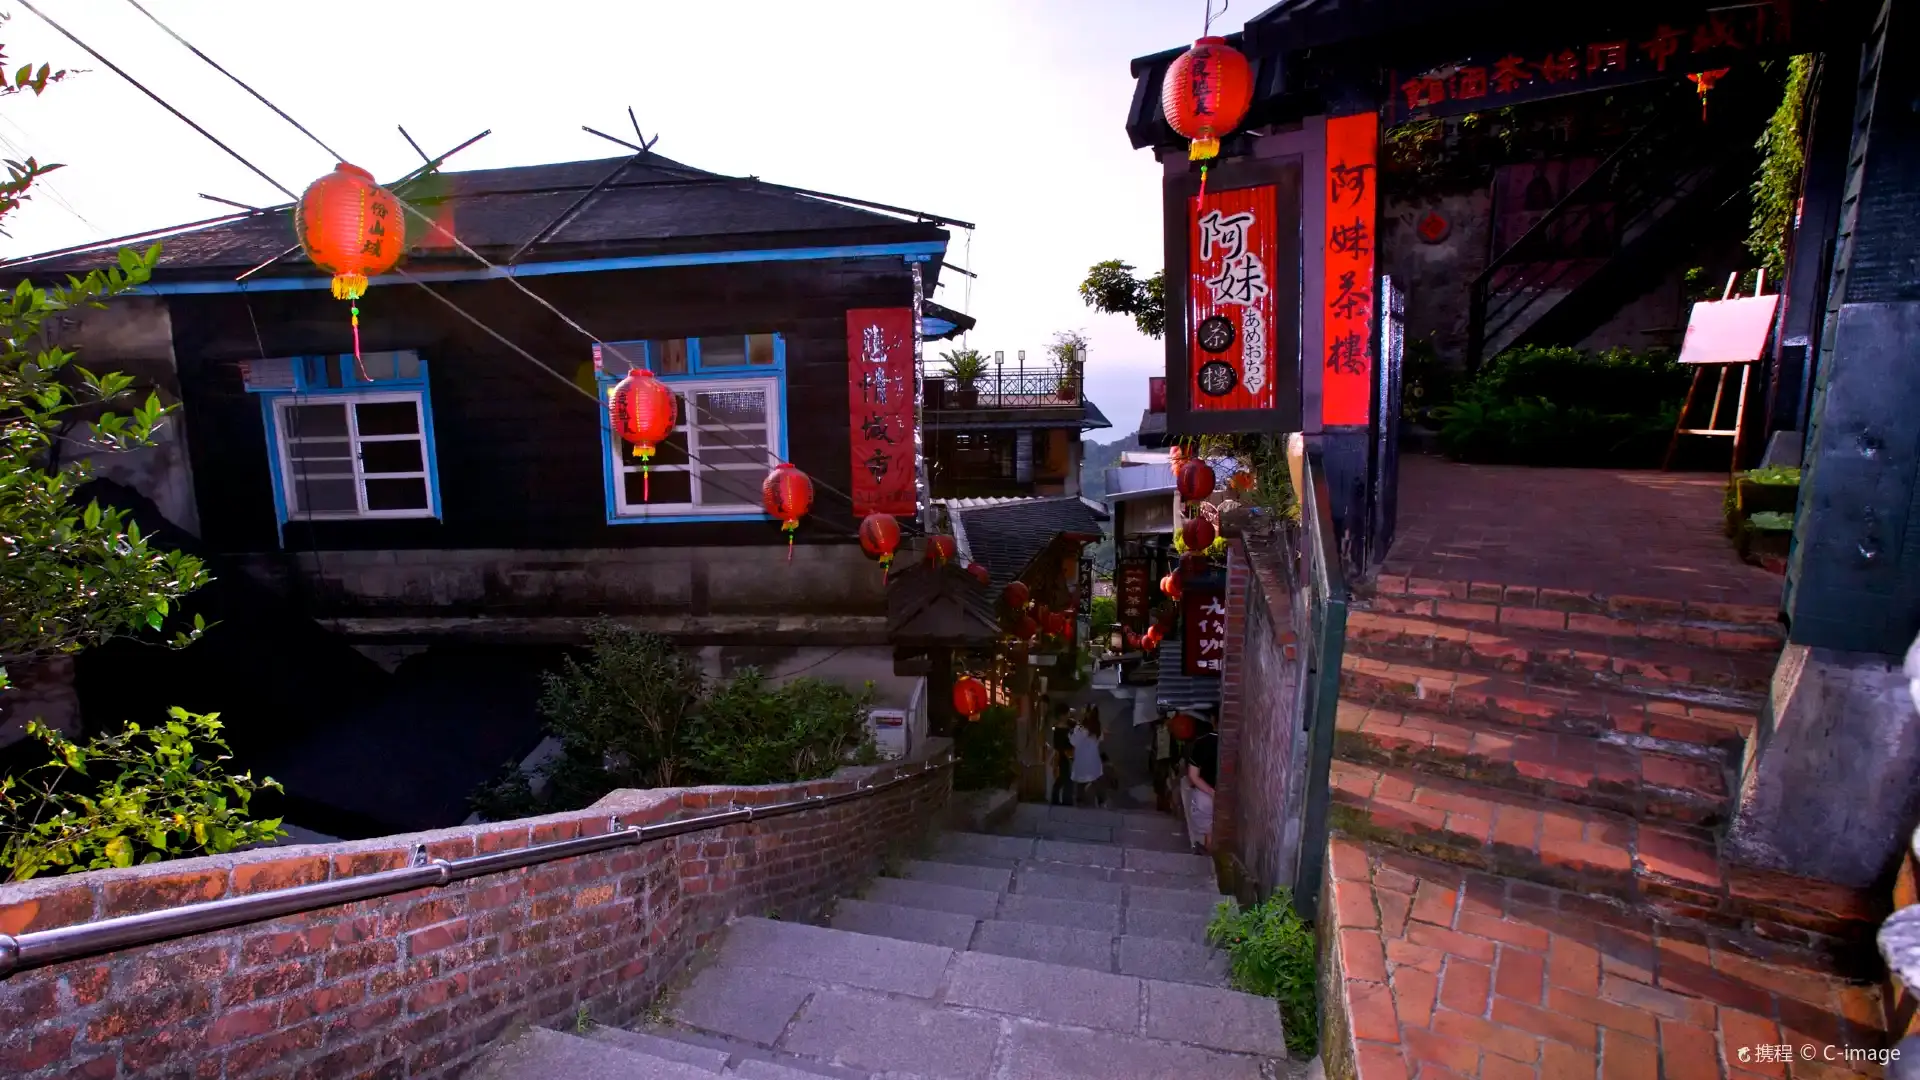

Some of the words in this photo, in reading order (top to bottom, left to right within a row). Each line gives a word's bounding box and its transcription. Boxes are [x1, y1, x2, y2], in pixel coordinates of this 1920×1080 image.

[1199, 210, 1268, 304] 阿妹
[1327, 163, 1376, 375] 阿妹茶樓
[1203, 321, 1230, 391] 茶樓
